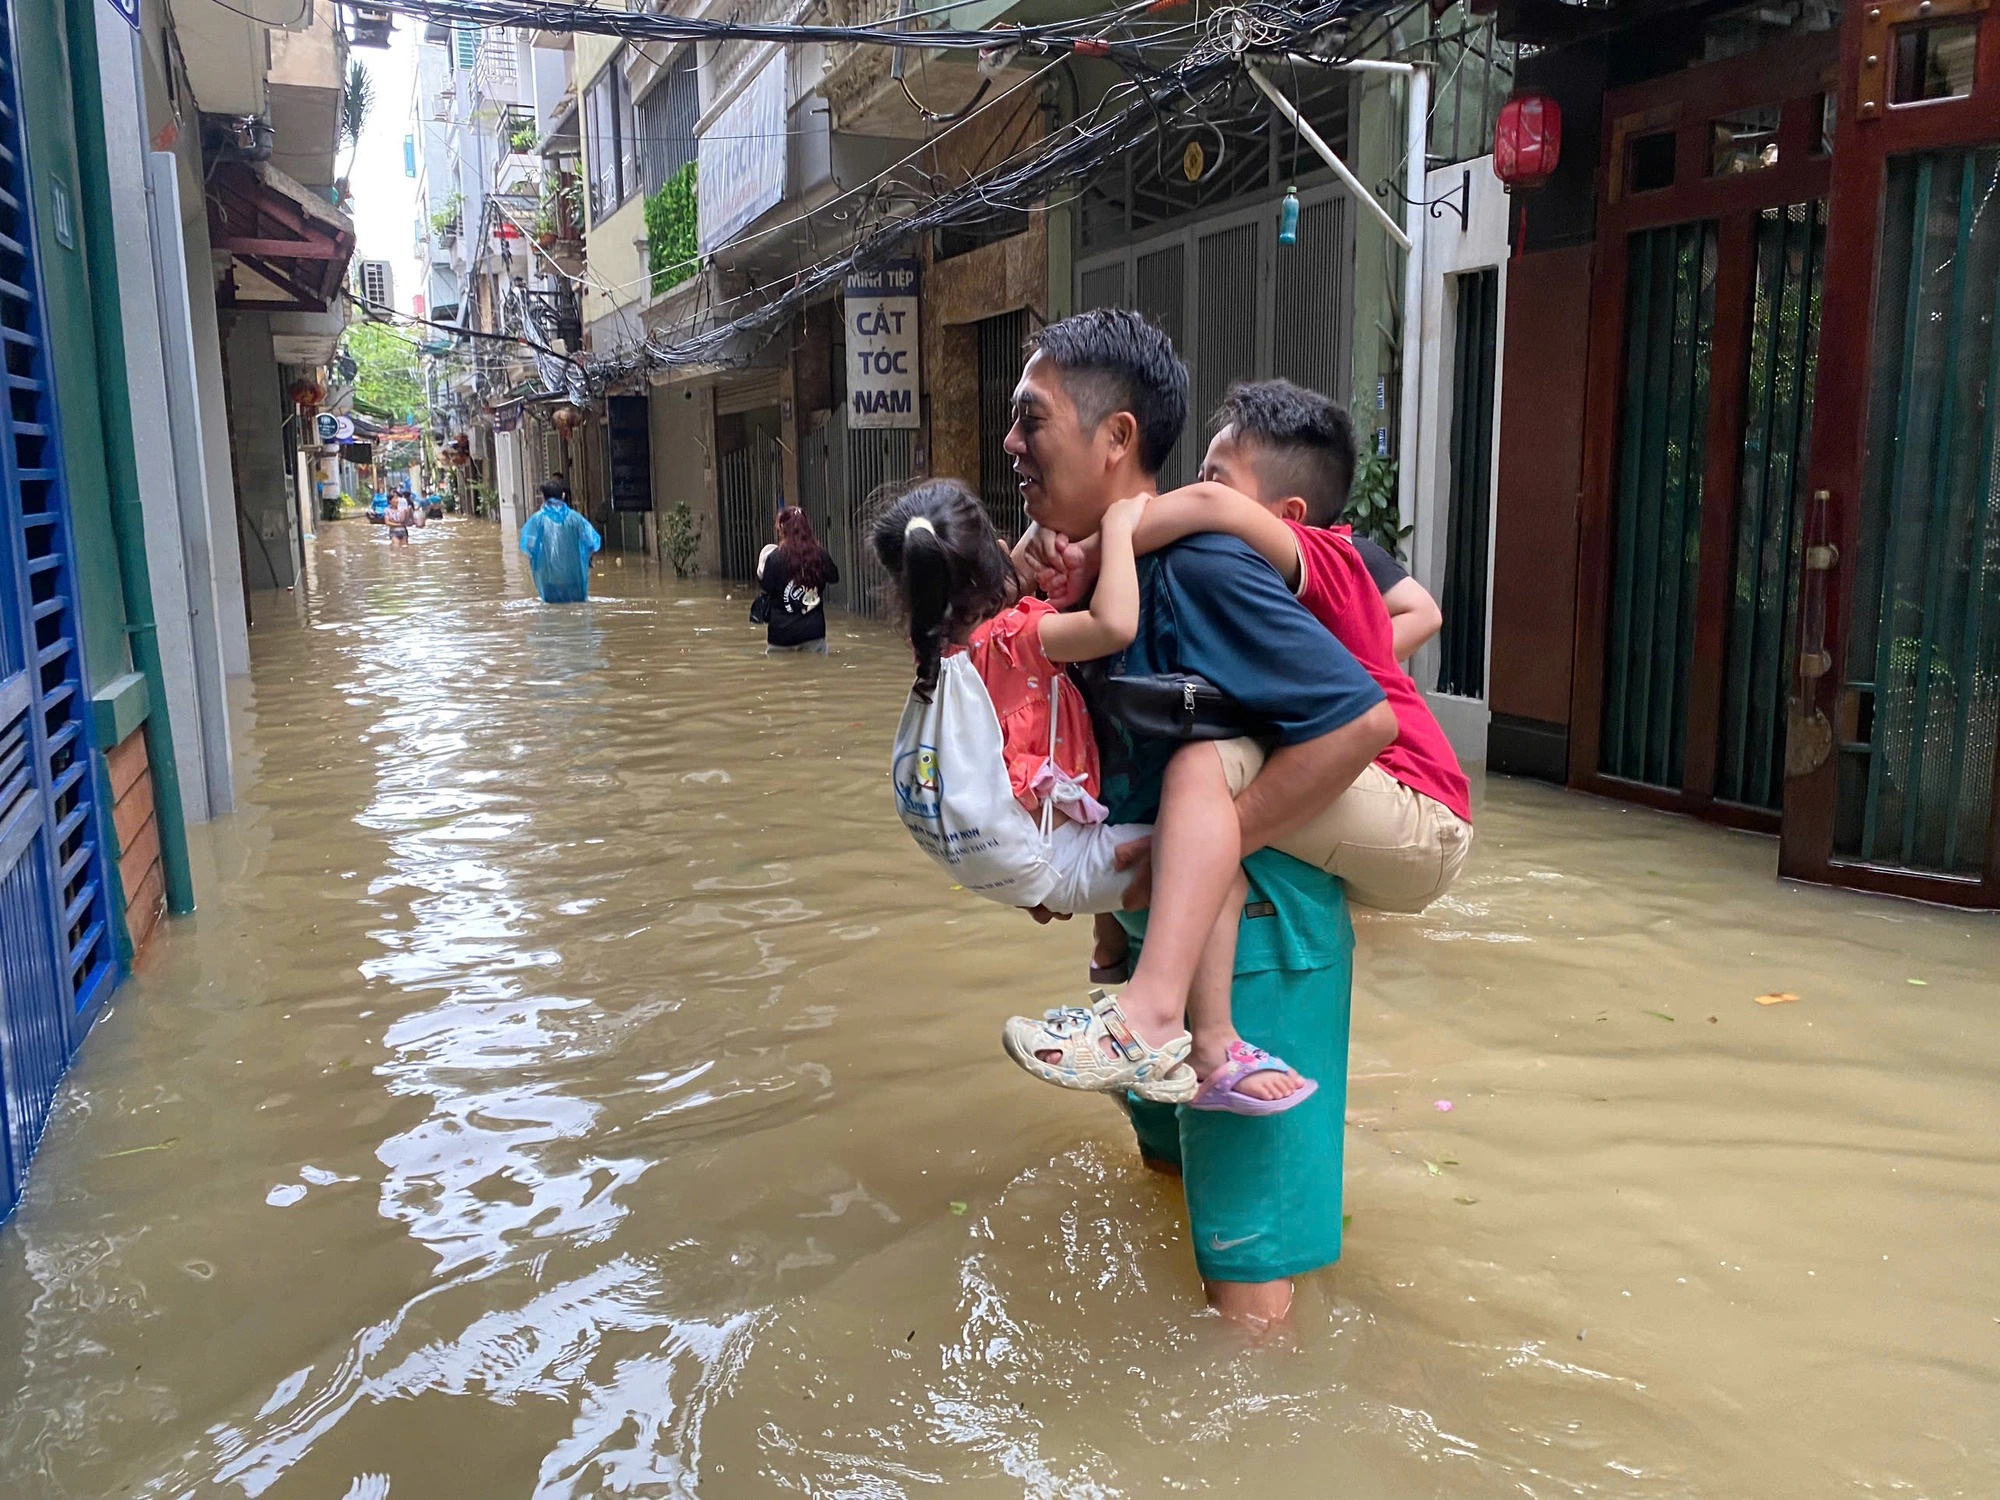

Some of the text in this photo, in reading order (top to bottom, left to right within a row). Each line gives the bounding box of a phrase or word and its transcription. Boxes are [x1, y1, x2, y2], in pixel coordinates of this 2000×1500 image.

[856, 303, 906, 336] CẮT
[858, 346, 908, 375] TÓC
[855, 390, 911, 413] NAM
